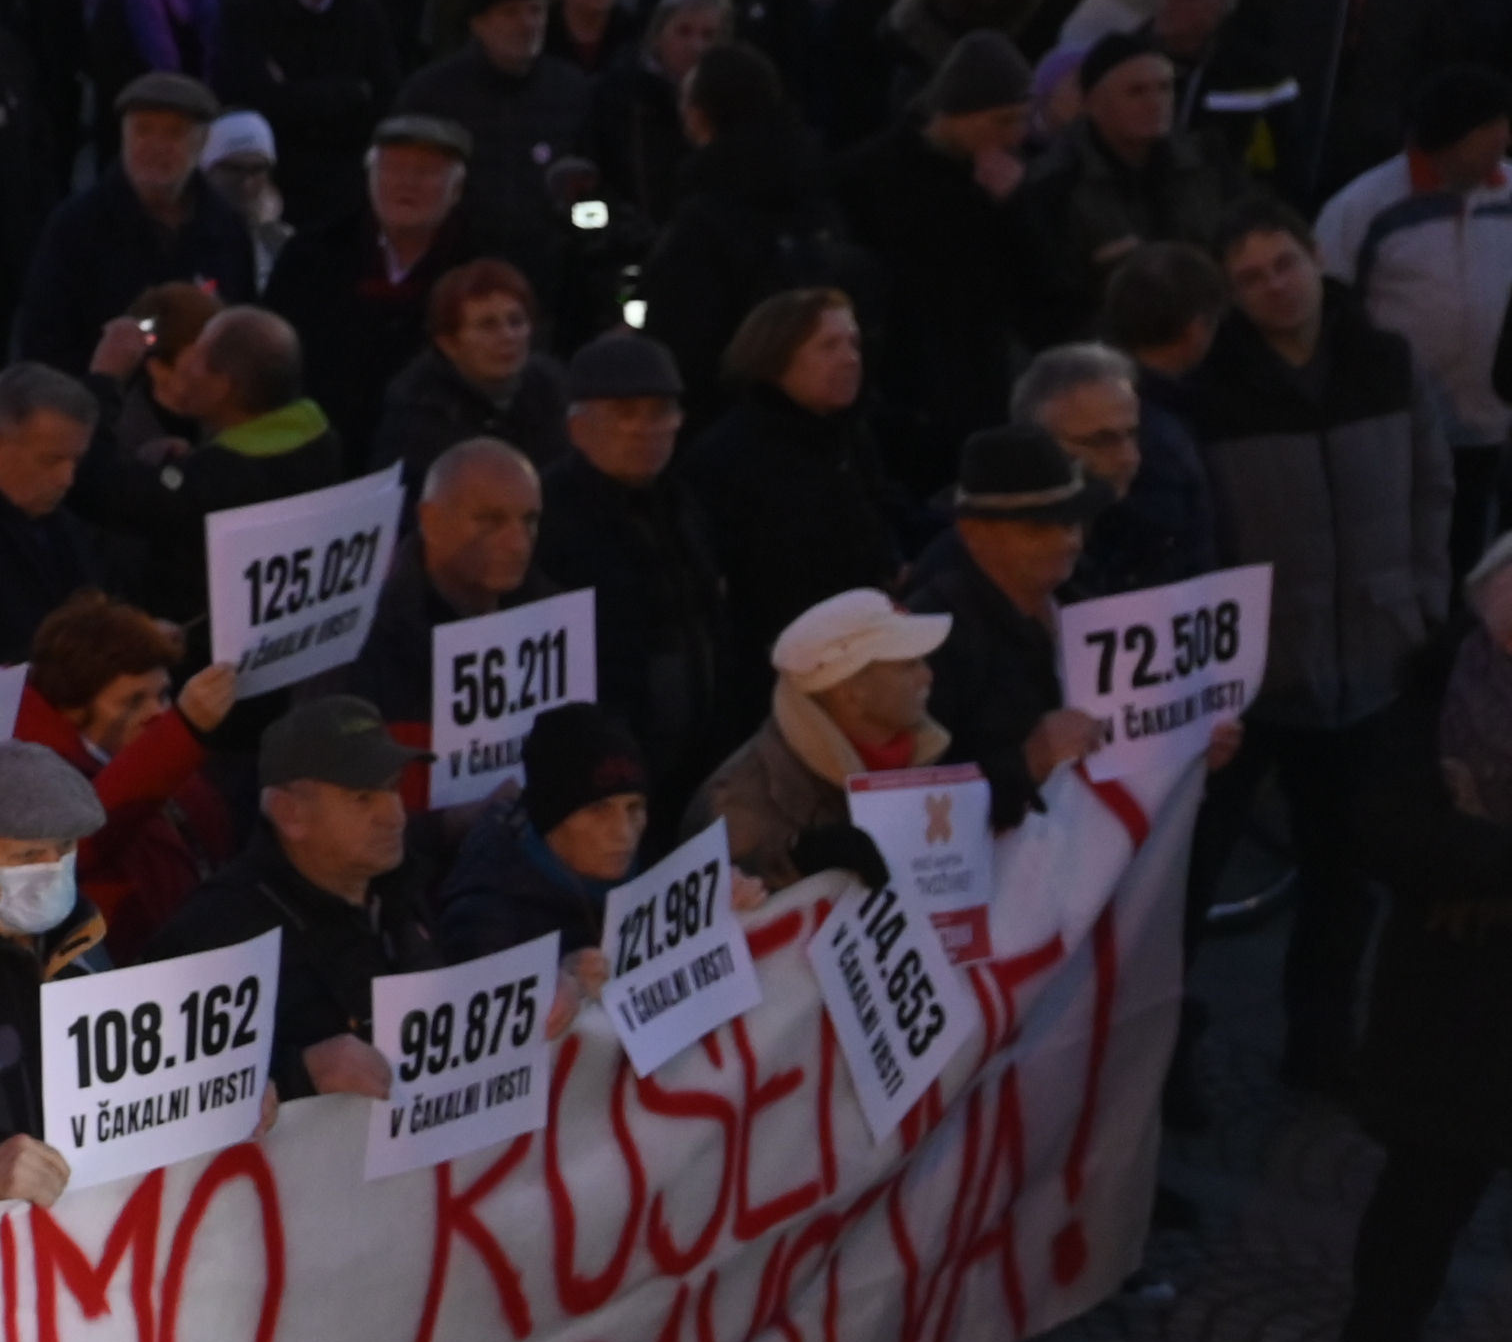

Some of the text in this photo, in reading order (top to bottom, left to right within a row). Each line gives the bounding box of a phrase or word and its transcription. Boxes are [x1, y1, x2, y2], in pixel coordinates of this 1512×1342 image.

[243, 525, 381, 627] 125.021
[451, 626, 568, 727] 56.211
[1084, 598, 1240, 695] 72.508
[615, 857, 720, 979] 121.987
[858, 885, 947, 1060] 114.653
[67, 974, 261, 1090] 108.162
[398, 974, 539, 1084] 99.875
[70, 1063, 256, 1149] V ČAKALNI VRSTI
[390, 1064, 532, 1140] V ČAKALNI VRSTI
